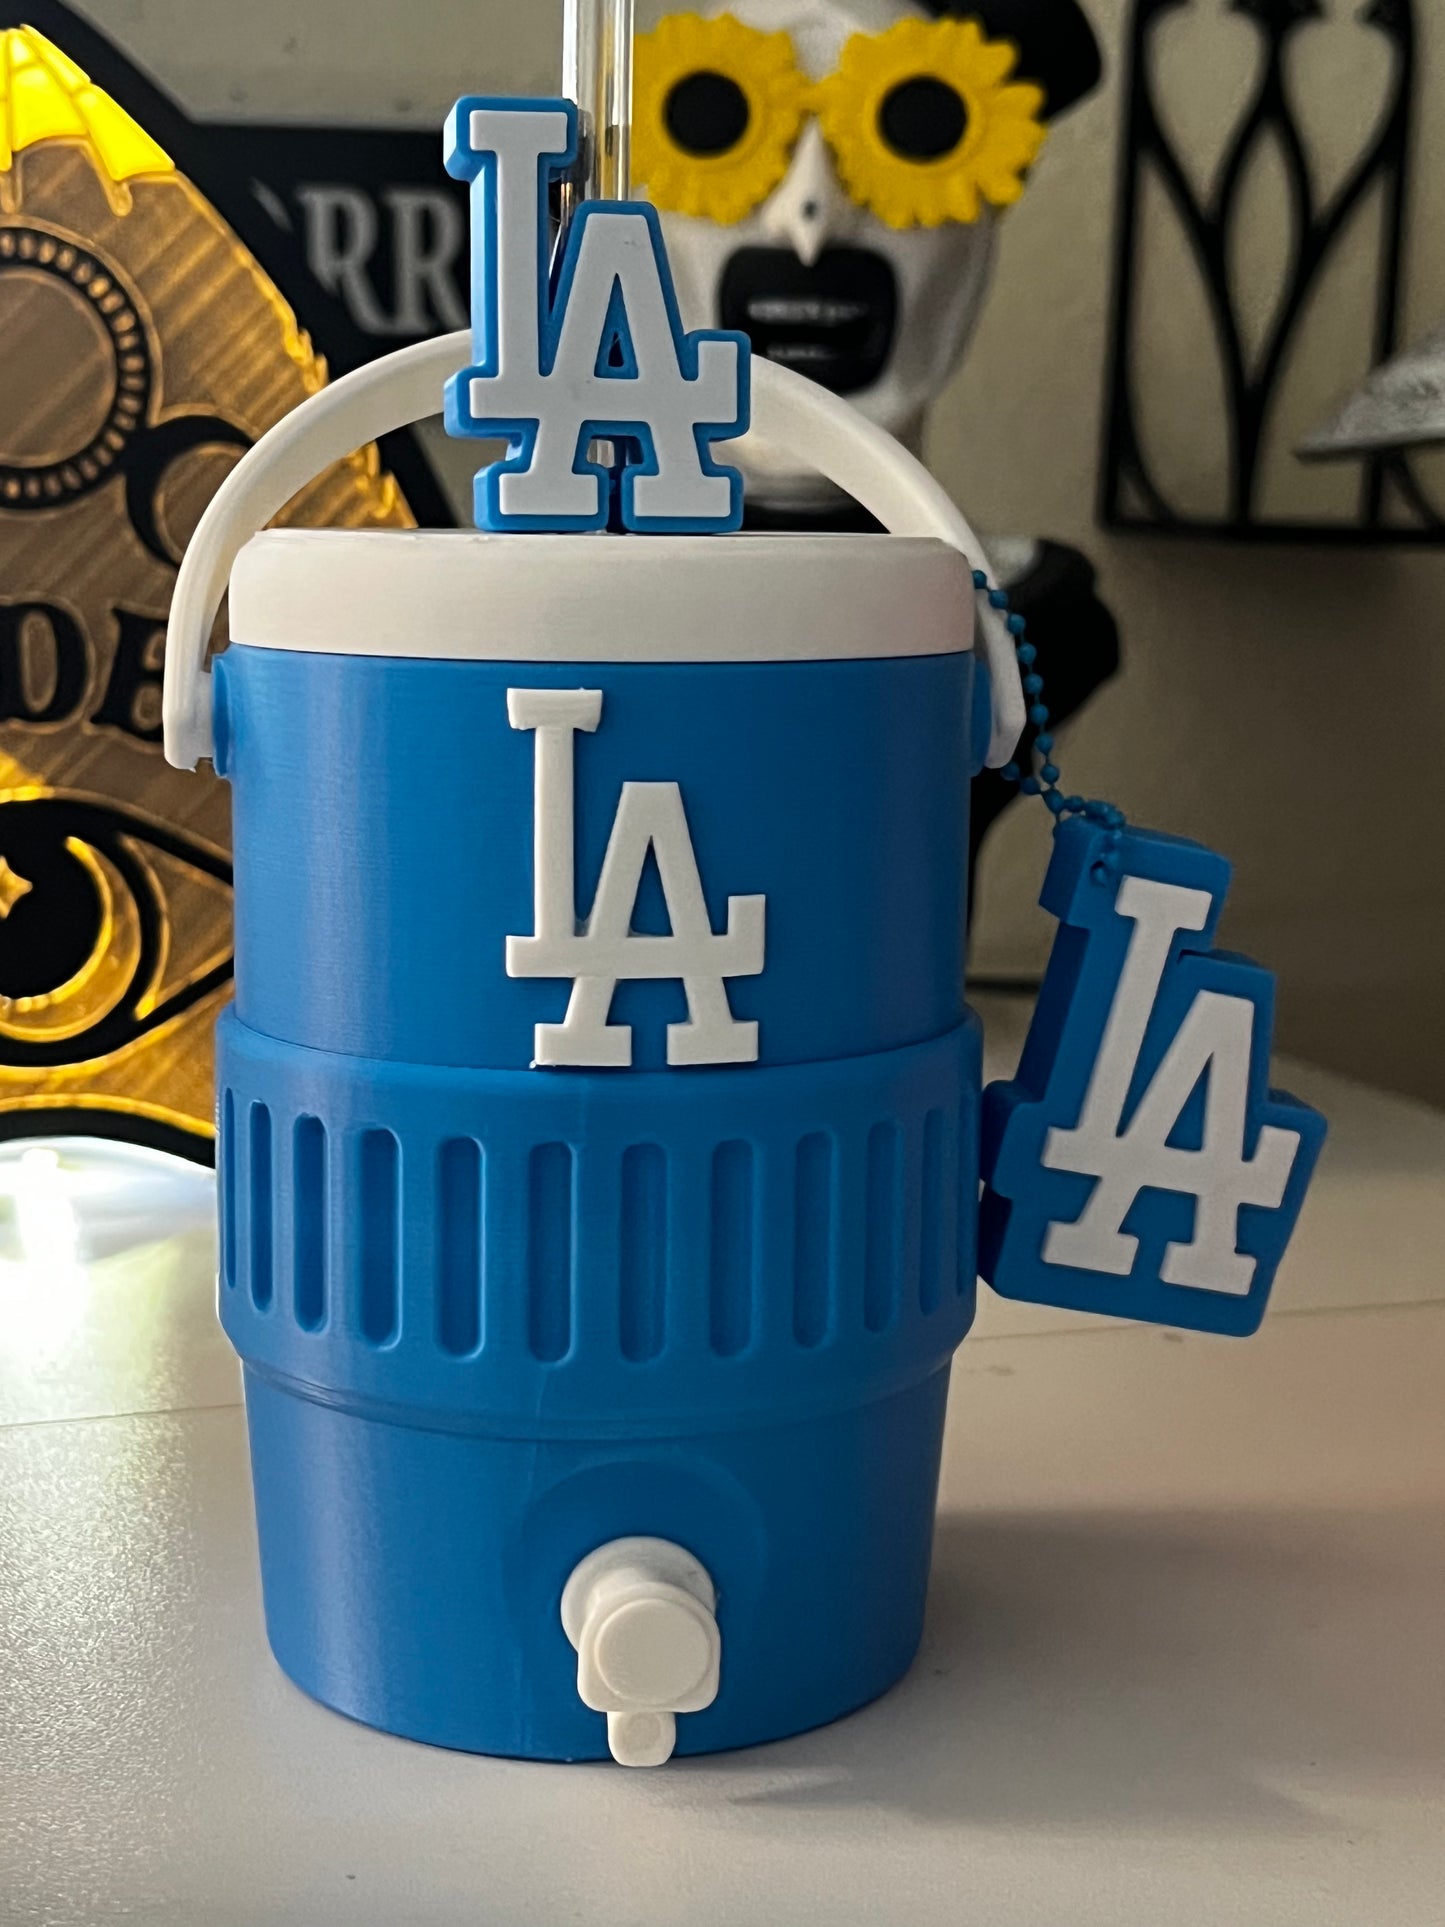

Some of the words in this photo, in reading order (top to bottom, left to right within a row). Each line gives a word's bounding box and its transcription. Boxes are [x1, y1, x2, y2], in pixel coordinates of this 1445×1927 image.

[469, 110, 739, 517] LA
[506, 687, 766, 1067] LA
[1040, 874, 1301, 1296] LA
